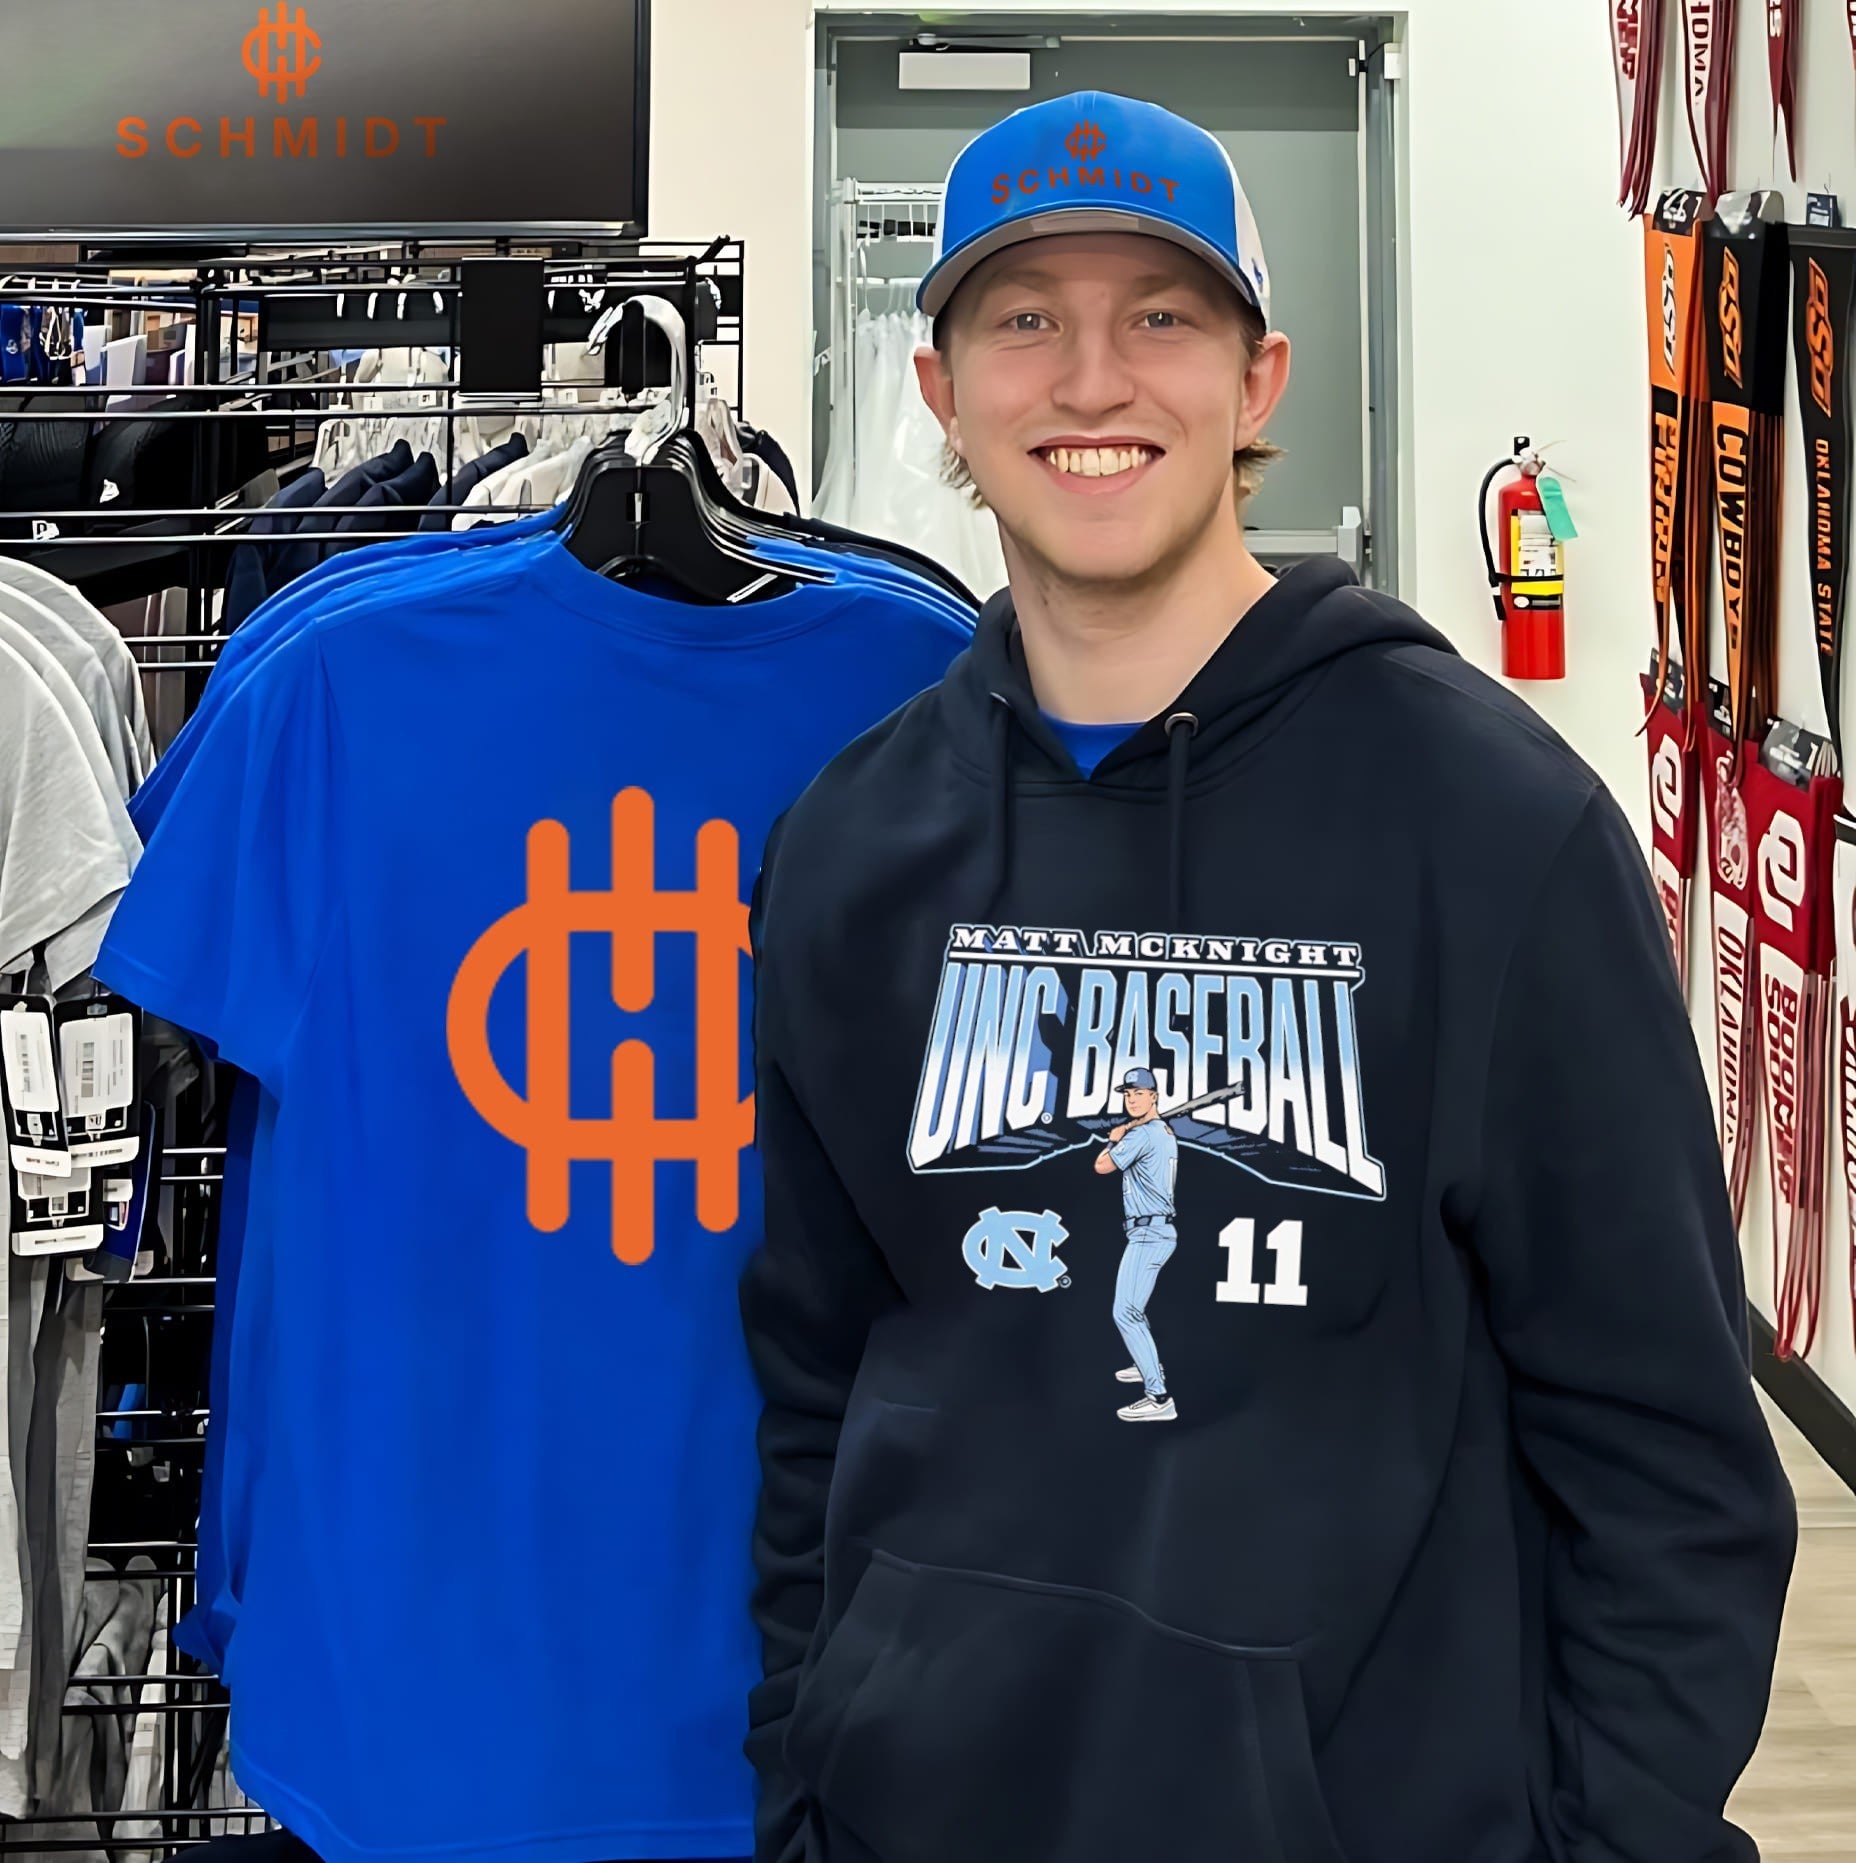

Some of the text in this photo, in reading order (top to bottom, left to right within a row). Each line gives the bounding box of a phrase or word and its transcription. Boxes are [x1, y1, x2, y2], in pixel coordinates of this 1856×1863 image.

[116, 116, 448, 160] SCHMIDT
[991, 166, 1179, 205] SCHMIDT
[1815, 438, 1833, 571] OKLAHOMA
[952, 926, 1359, 967] MATT MCKNIGHT
[911, 962, 1385, 1196] UNC BASEBALL
[1215, 1217, 1308, 1306] 11
